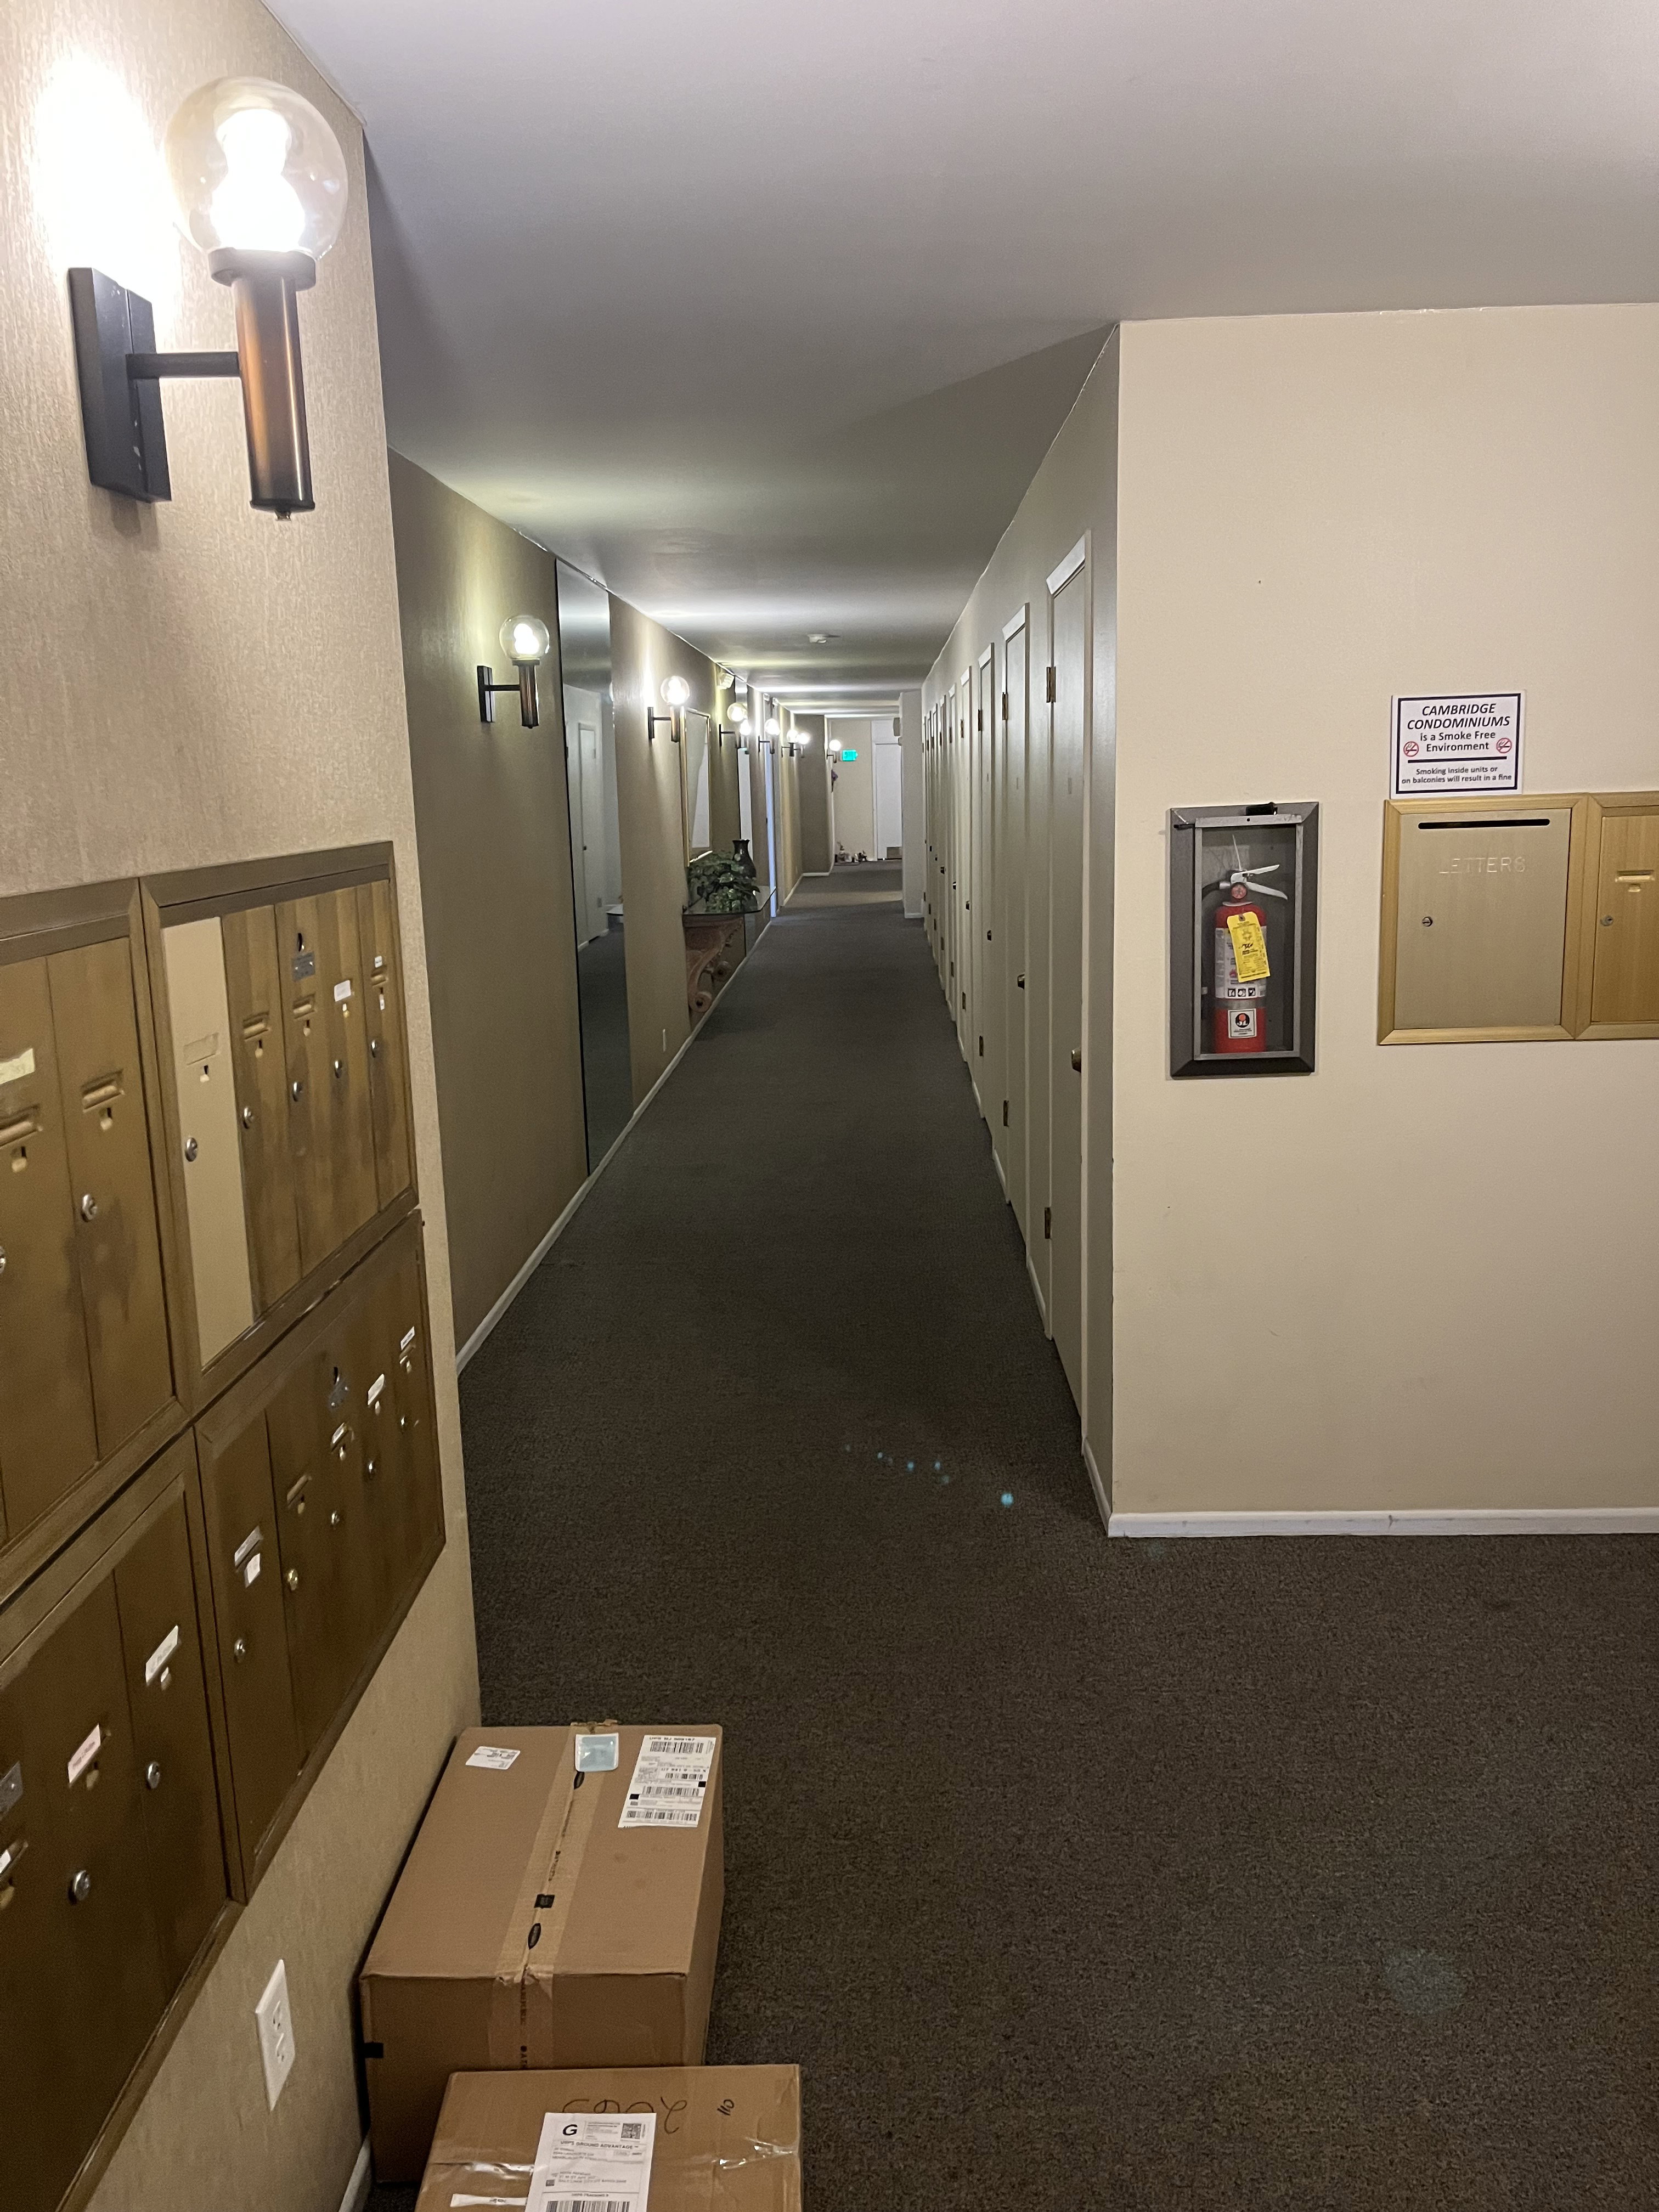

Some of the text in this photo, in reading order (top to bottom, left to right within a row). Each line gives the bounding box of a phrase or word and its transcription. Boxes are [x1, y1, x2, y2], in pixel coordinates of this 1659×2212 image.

[1423, 703, 1496, 715] CAMBRIDGE
[1407, 716, 1510, 729] CONDOMINIUMS
[1438, 732, 1471, 740] Smoke
[1426, 742, 1489, 752] Environment
[562, 2124, 578, 2136] G
